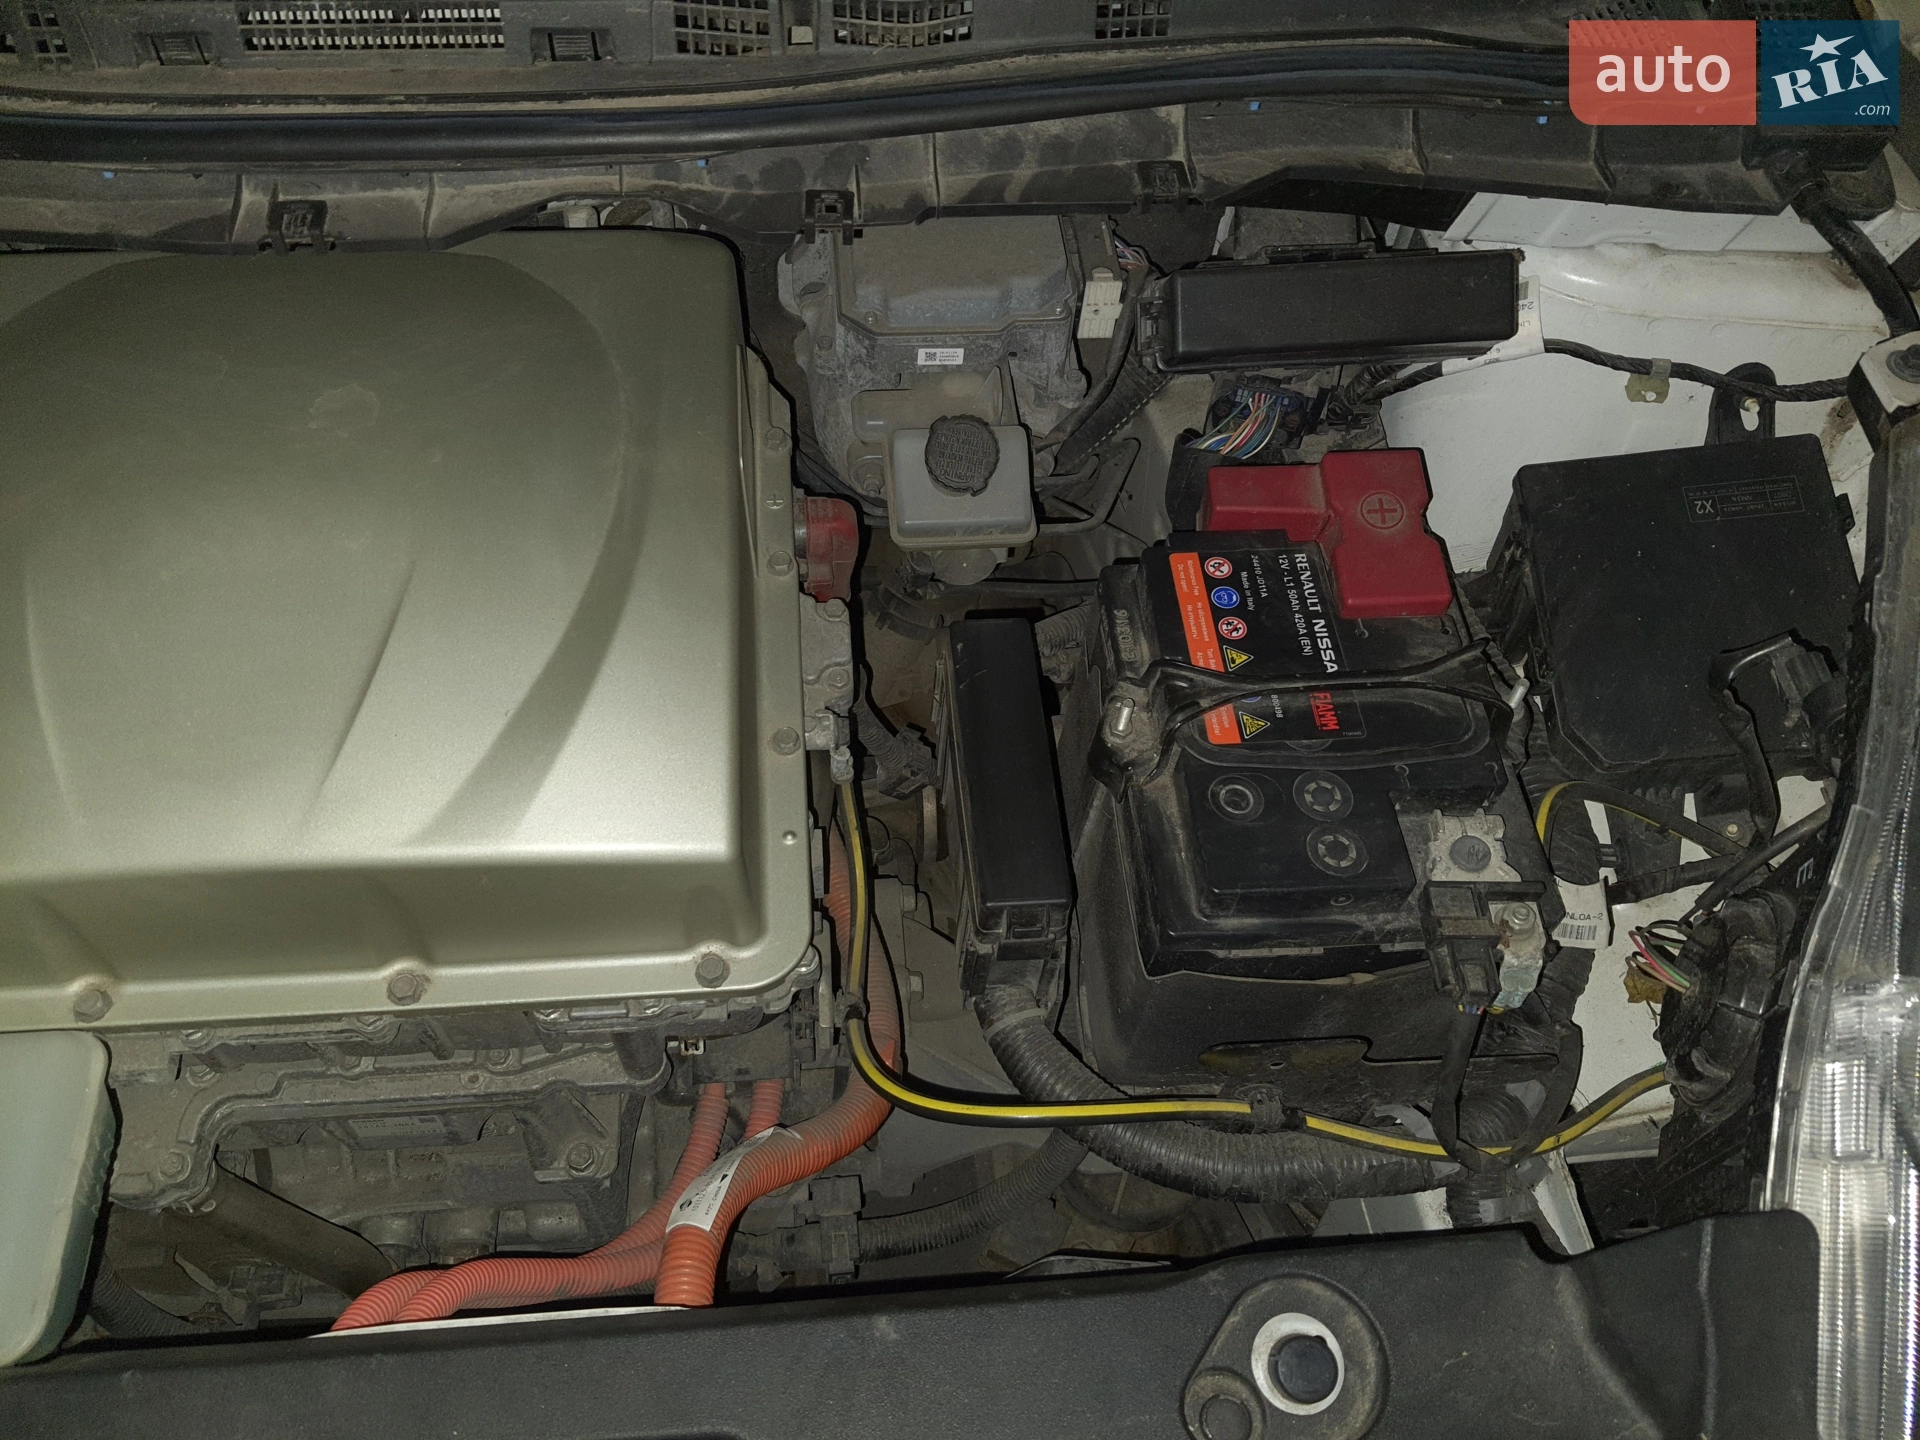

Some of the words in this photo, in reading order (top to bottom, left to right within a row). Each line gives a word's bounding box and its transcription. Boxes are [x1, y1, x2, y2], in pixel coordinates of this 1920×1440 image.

[1694, 499, 1714, 515] X2
[1278, 554, 1291, 570] 12V
[1240, 571, 1250, 589] Made
[1250, 554, 1262, 575] 24410
[1256, 575, 1268, 598] JD11A
[1283, 576, 1295, 587] L1
[1244, 589, 1252, 597] in
[1287, 589, 1301, 611] 50Ah
[1246, 597, 1256, 611] Italy
[1294, 553, 1322, 613] RENAULT
[1311, 619, 1339, 673] NISSA
[1294, 612, 1308, 635] 420A
[1298, 636, 1314, 656] (EN)
[1271, 694, 1284, 718] 800498
[1312, 692, 1340, 731] FIAMM
